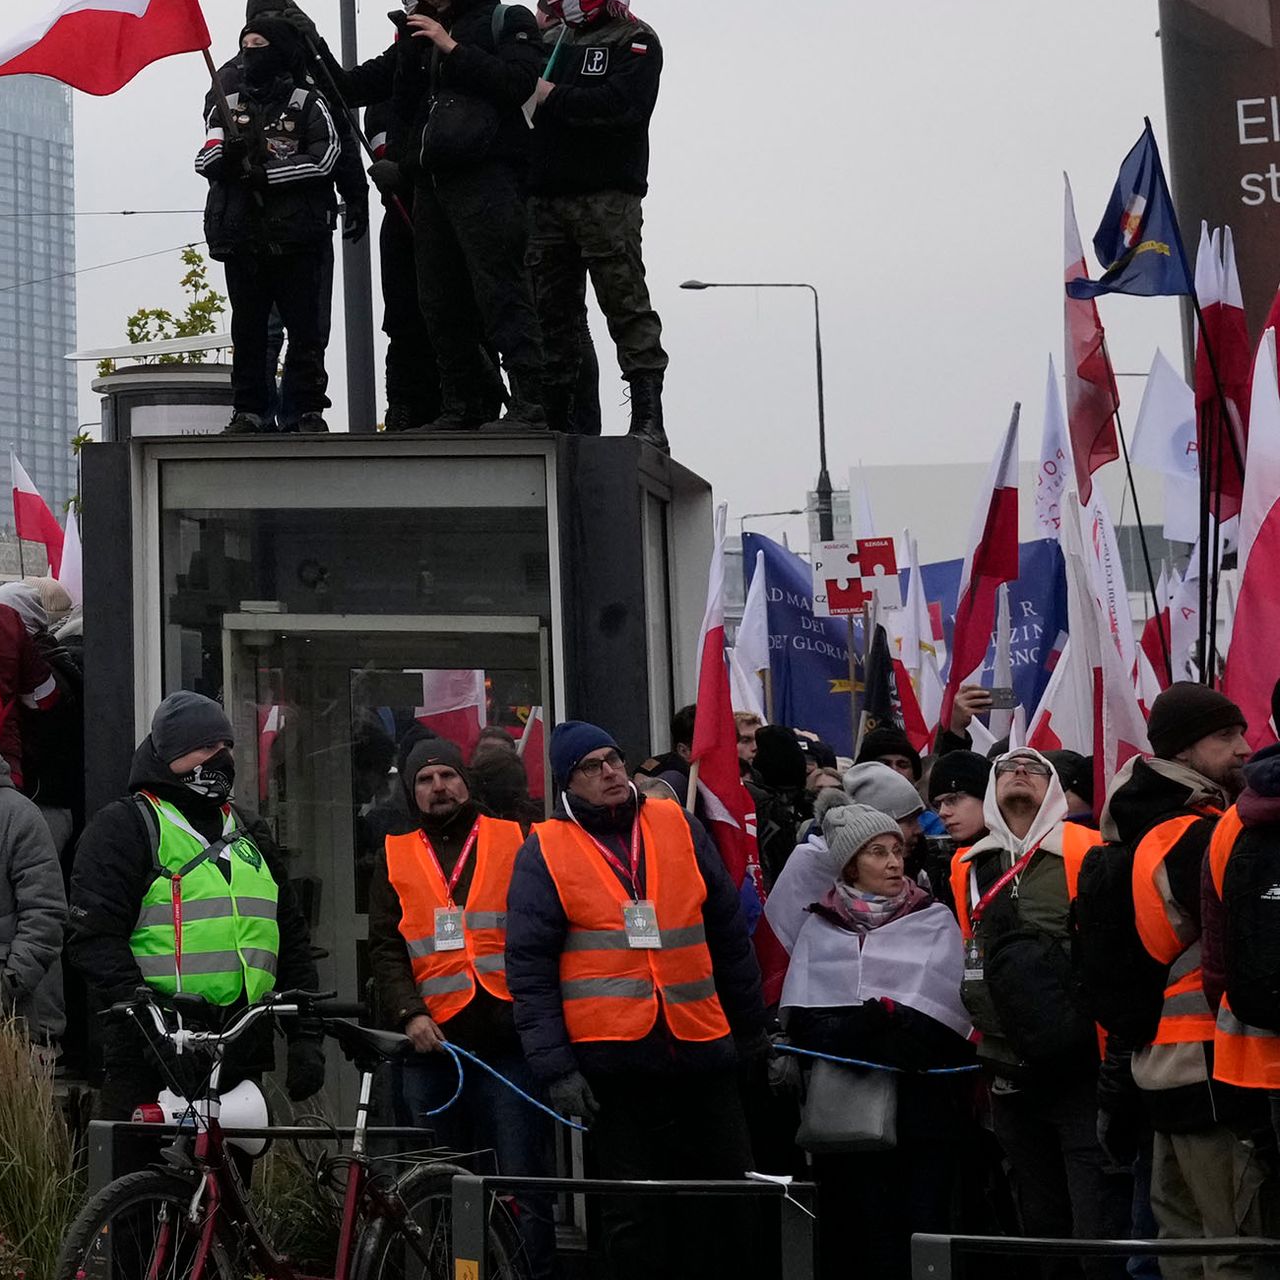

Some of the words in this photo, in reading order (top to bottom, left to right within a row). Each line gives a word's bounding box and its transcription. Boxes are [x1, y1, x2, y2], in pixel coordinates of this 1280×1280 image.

[1237, 96, 1280, 144] El
[1241, 163, 1280, 205] st
[801, 616, 826, 636] DEI
